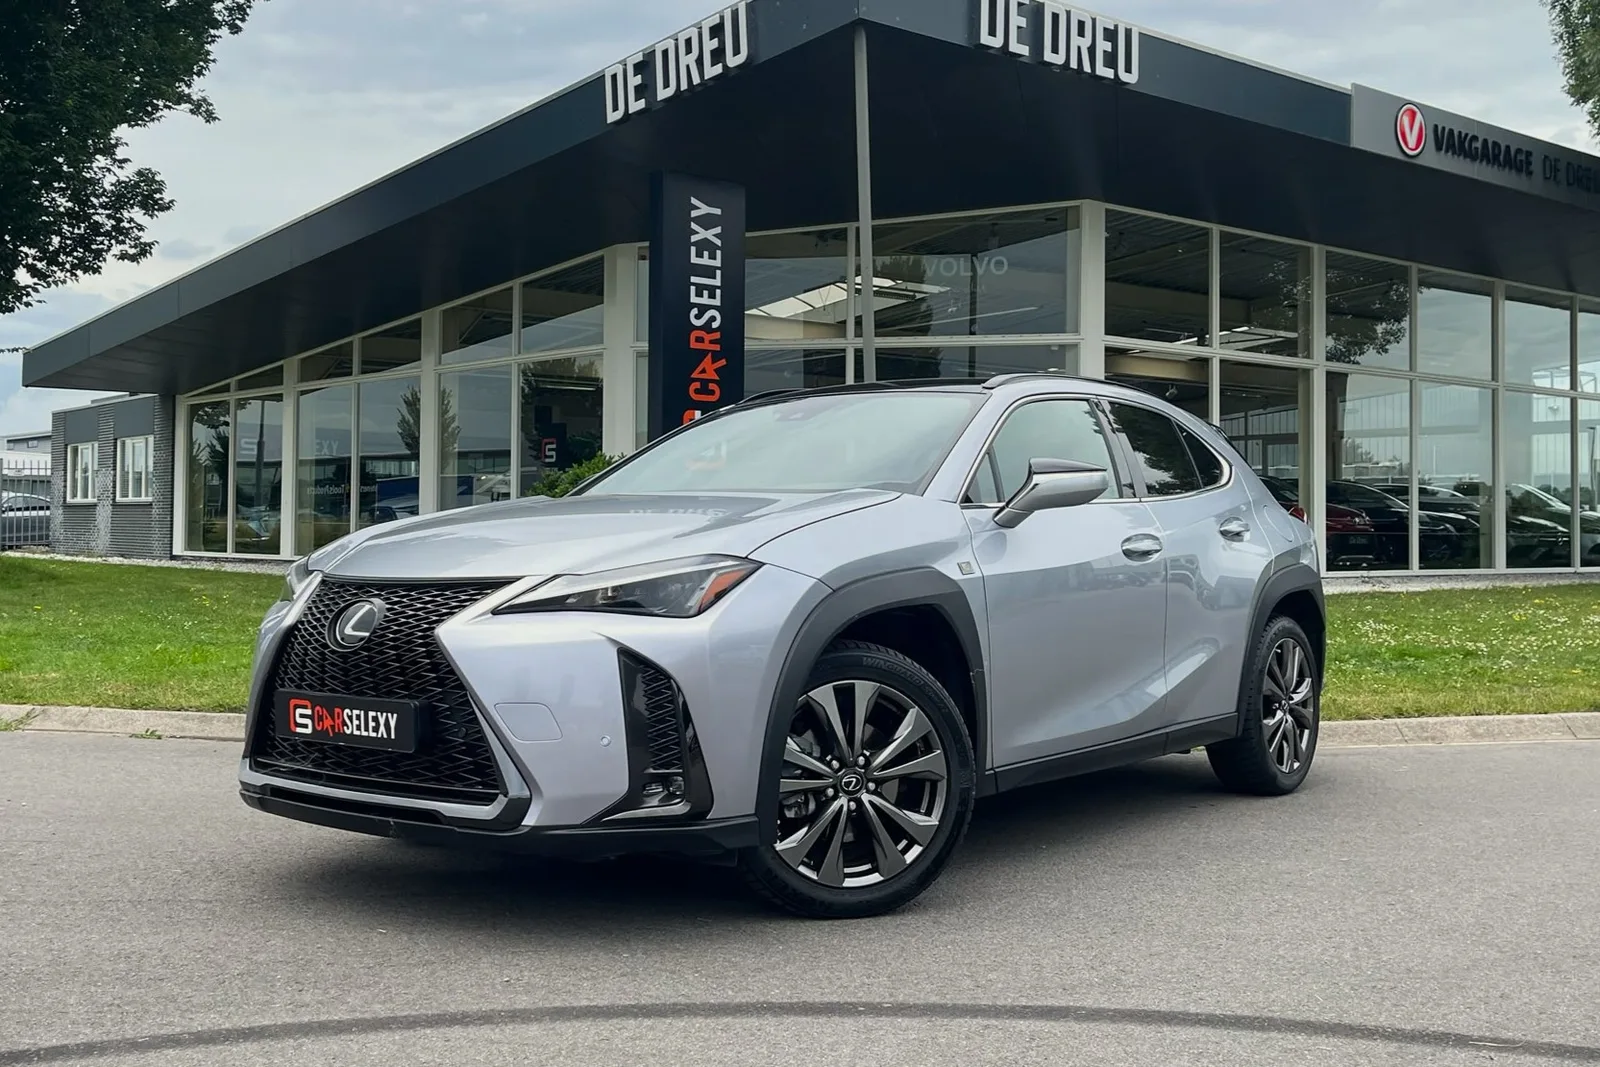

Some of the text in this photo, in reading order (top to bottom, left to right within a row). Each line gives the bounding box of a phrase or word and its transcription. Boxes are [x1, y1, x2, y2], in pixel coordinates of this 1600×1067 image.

[605, 1, 748, 124] DE DREU
[980, 0, 1139, 84] DE DREU
[1432, 123, 1533, 177] VAKGARAGE
[1543, 154, 1561, 184] DE
[689, 196, 727, 402] CARSELEXY
[924, 256, 1009, 277] VOLVO
[314, 705, 398, 739] CARSELEXY
